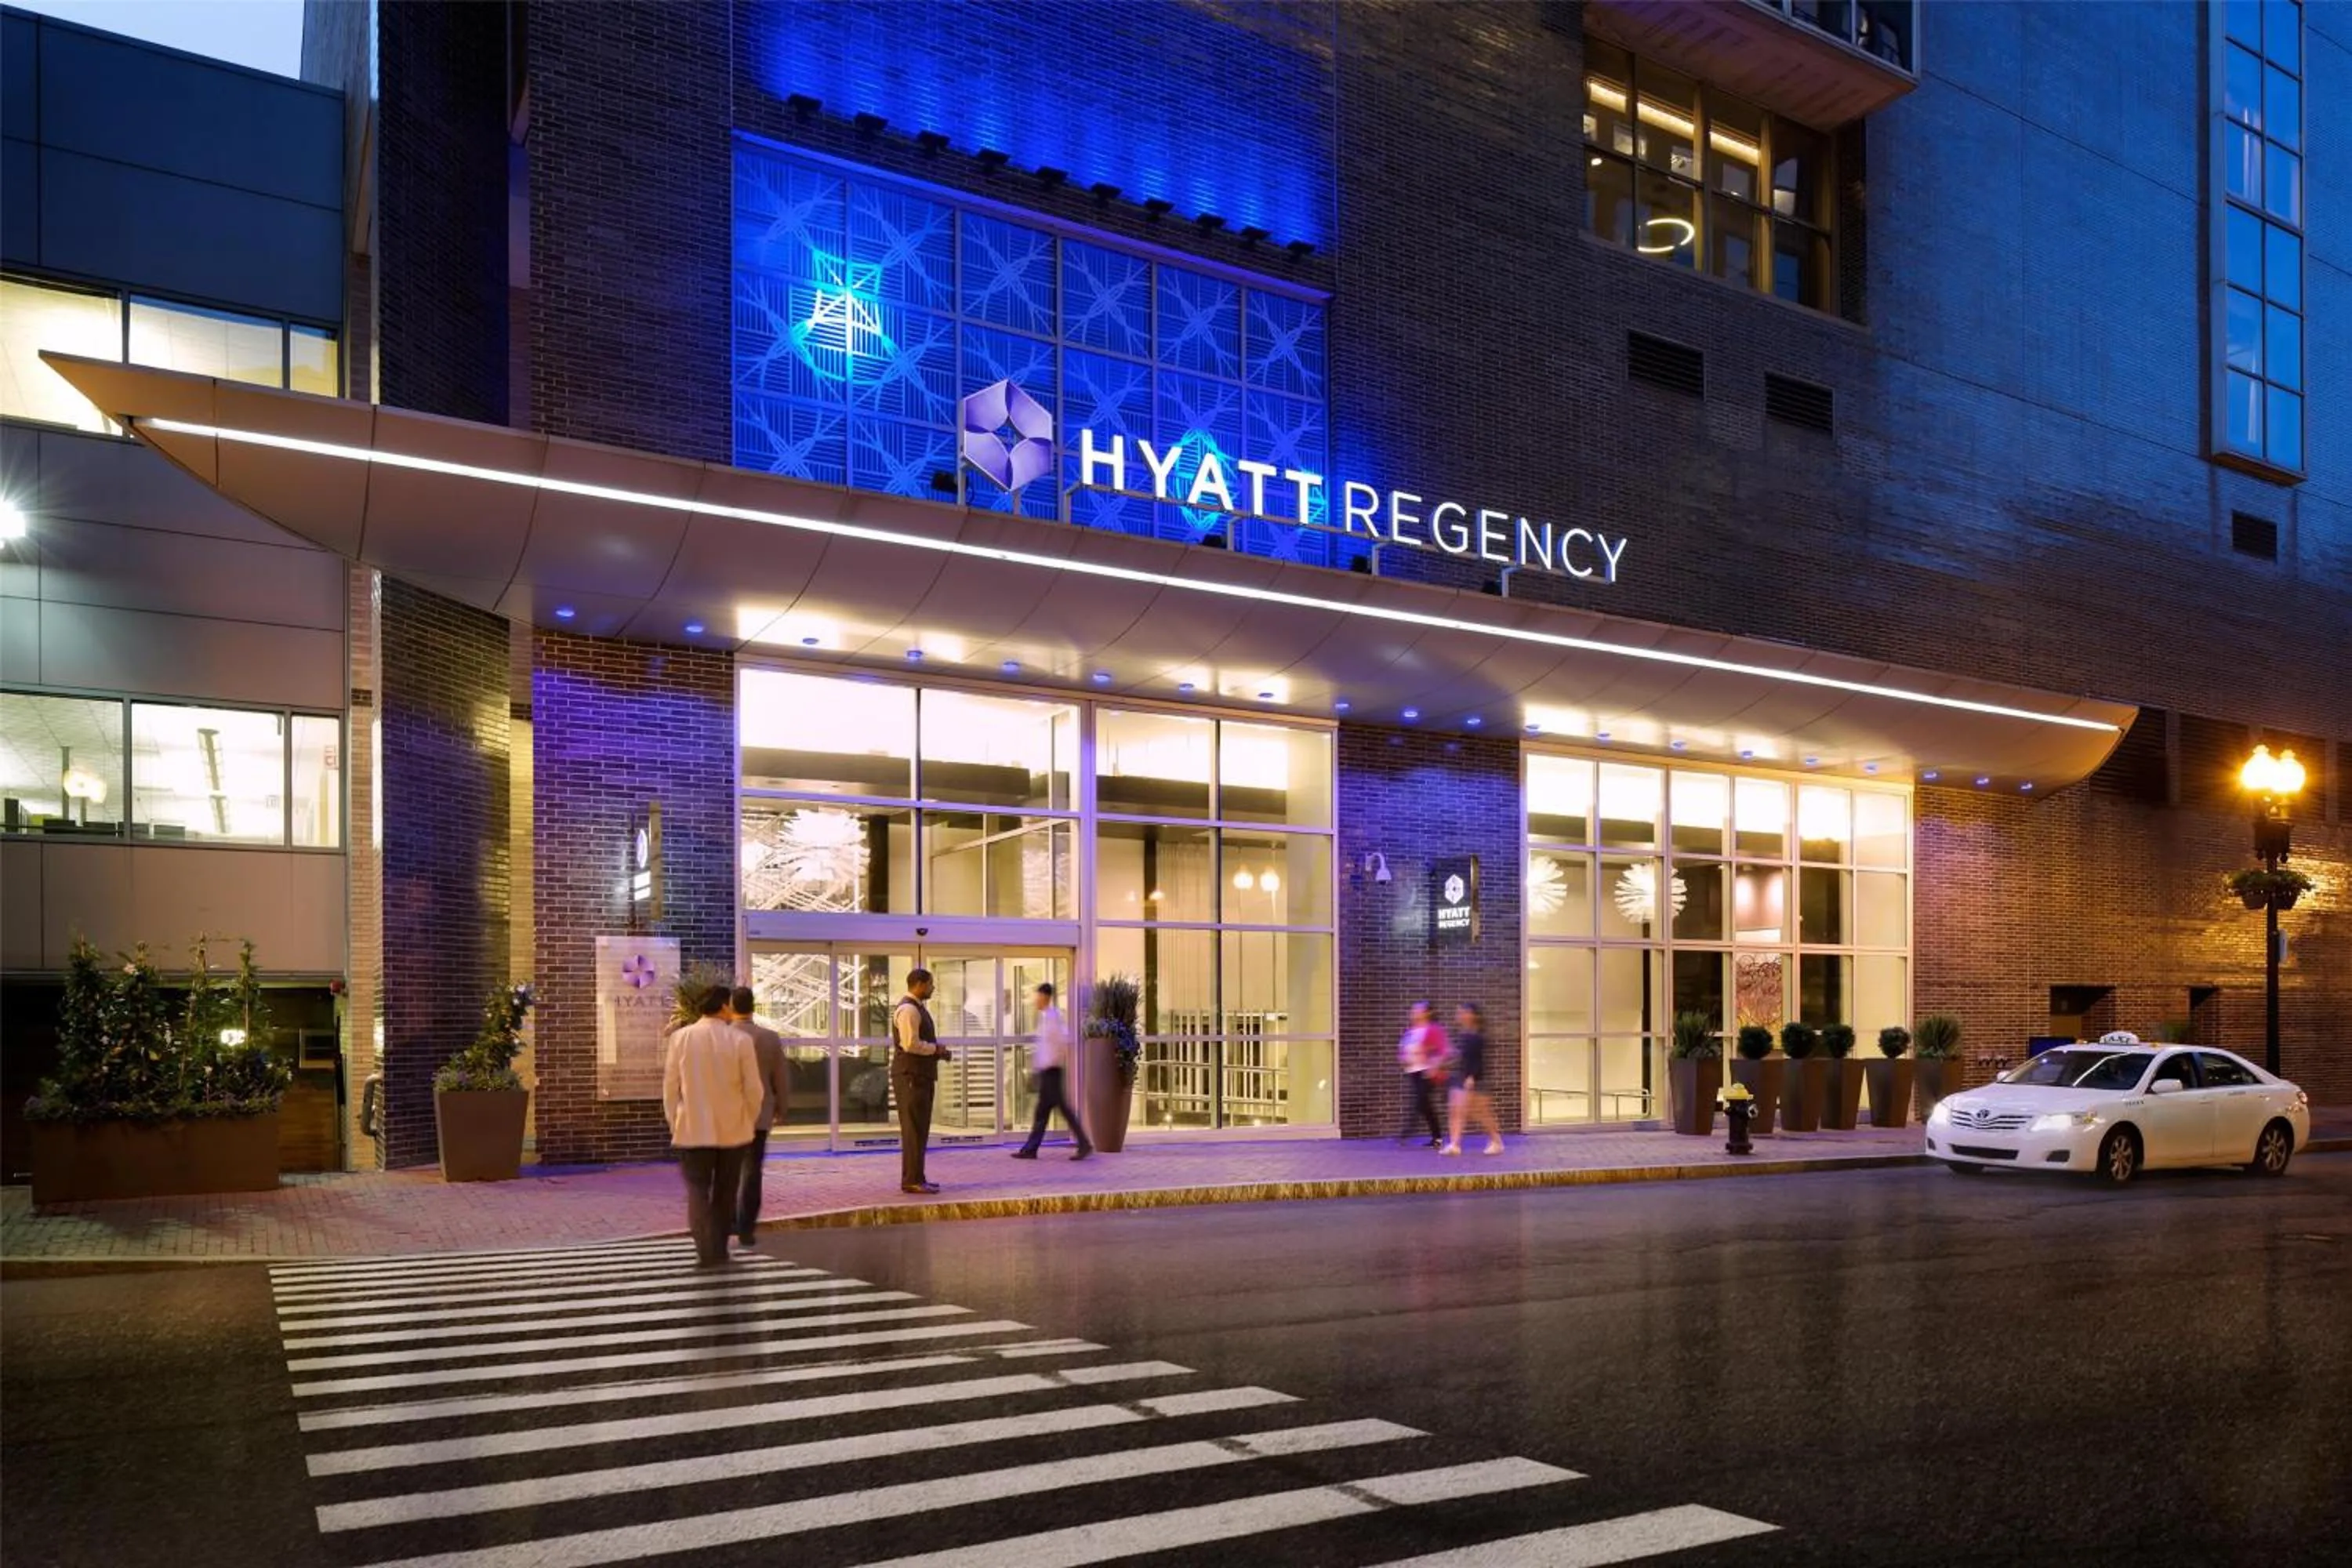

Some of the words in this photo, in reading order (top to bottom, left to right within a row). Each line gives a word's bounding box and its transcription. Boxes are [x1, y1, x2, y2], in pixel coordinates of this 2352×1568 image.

[1080, 428, 1323, 525] HYATT
[1343, 481, 1628, 583] REGENCY
[1438, 906, 1470, 920] HYATT
[1439, 918, 1470, 928] REGENCY
